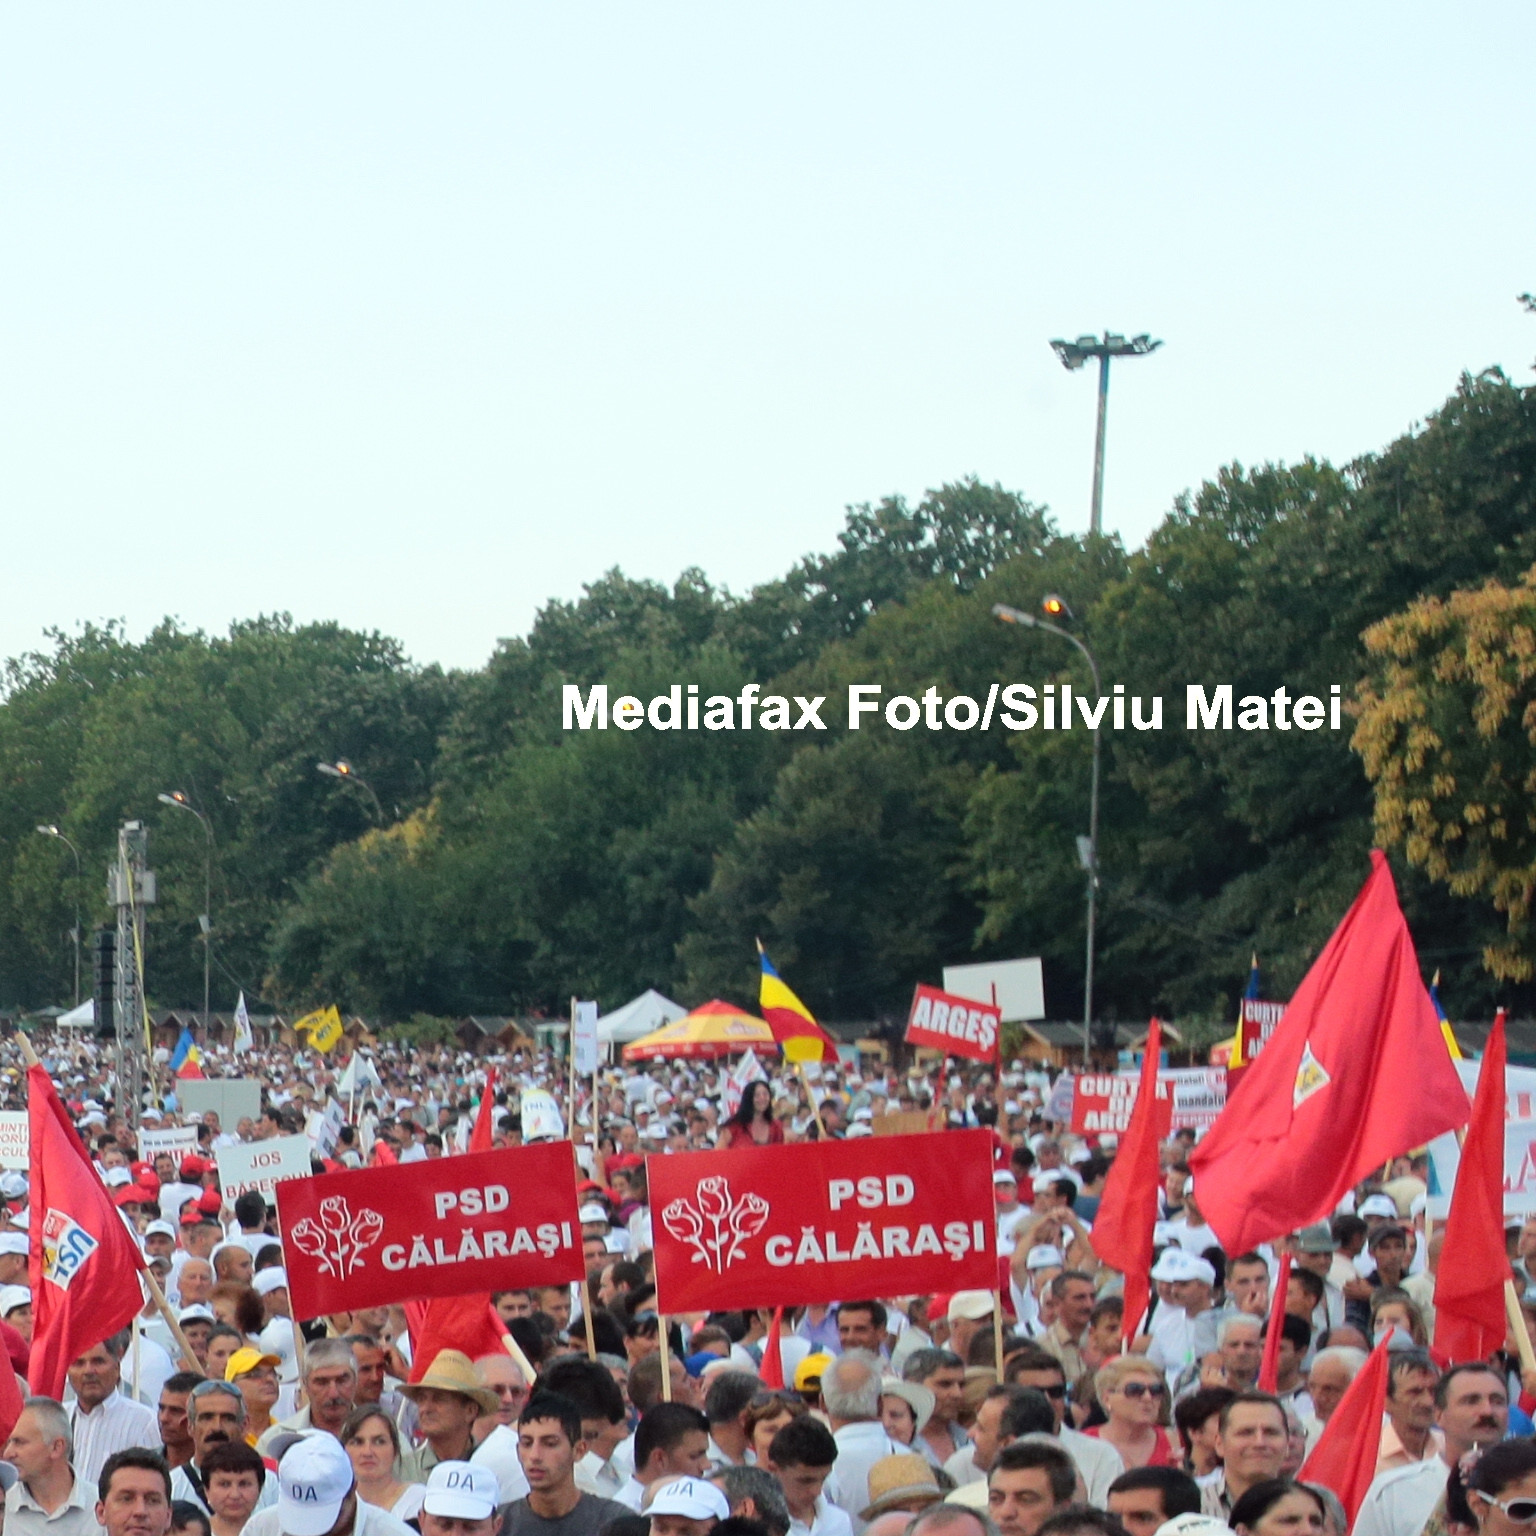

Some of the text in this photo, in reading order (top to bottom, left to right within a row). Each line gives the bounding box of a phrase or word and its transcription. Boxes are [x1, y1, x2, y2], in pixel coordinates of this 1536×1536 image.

[1080, 1074, 1168, 1100] CURTA
[250, 1151, 281, 1169] JOS
[434, 1183, 510, 1220] PSD
[829, 1174, 914, 1212] PSD
[292, 1484, 318, 1502] DA
[447, 1471, 474, 1493] DA
